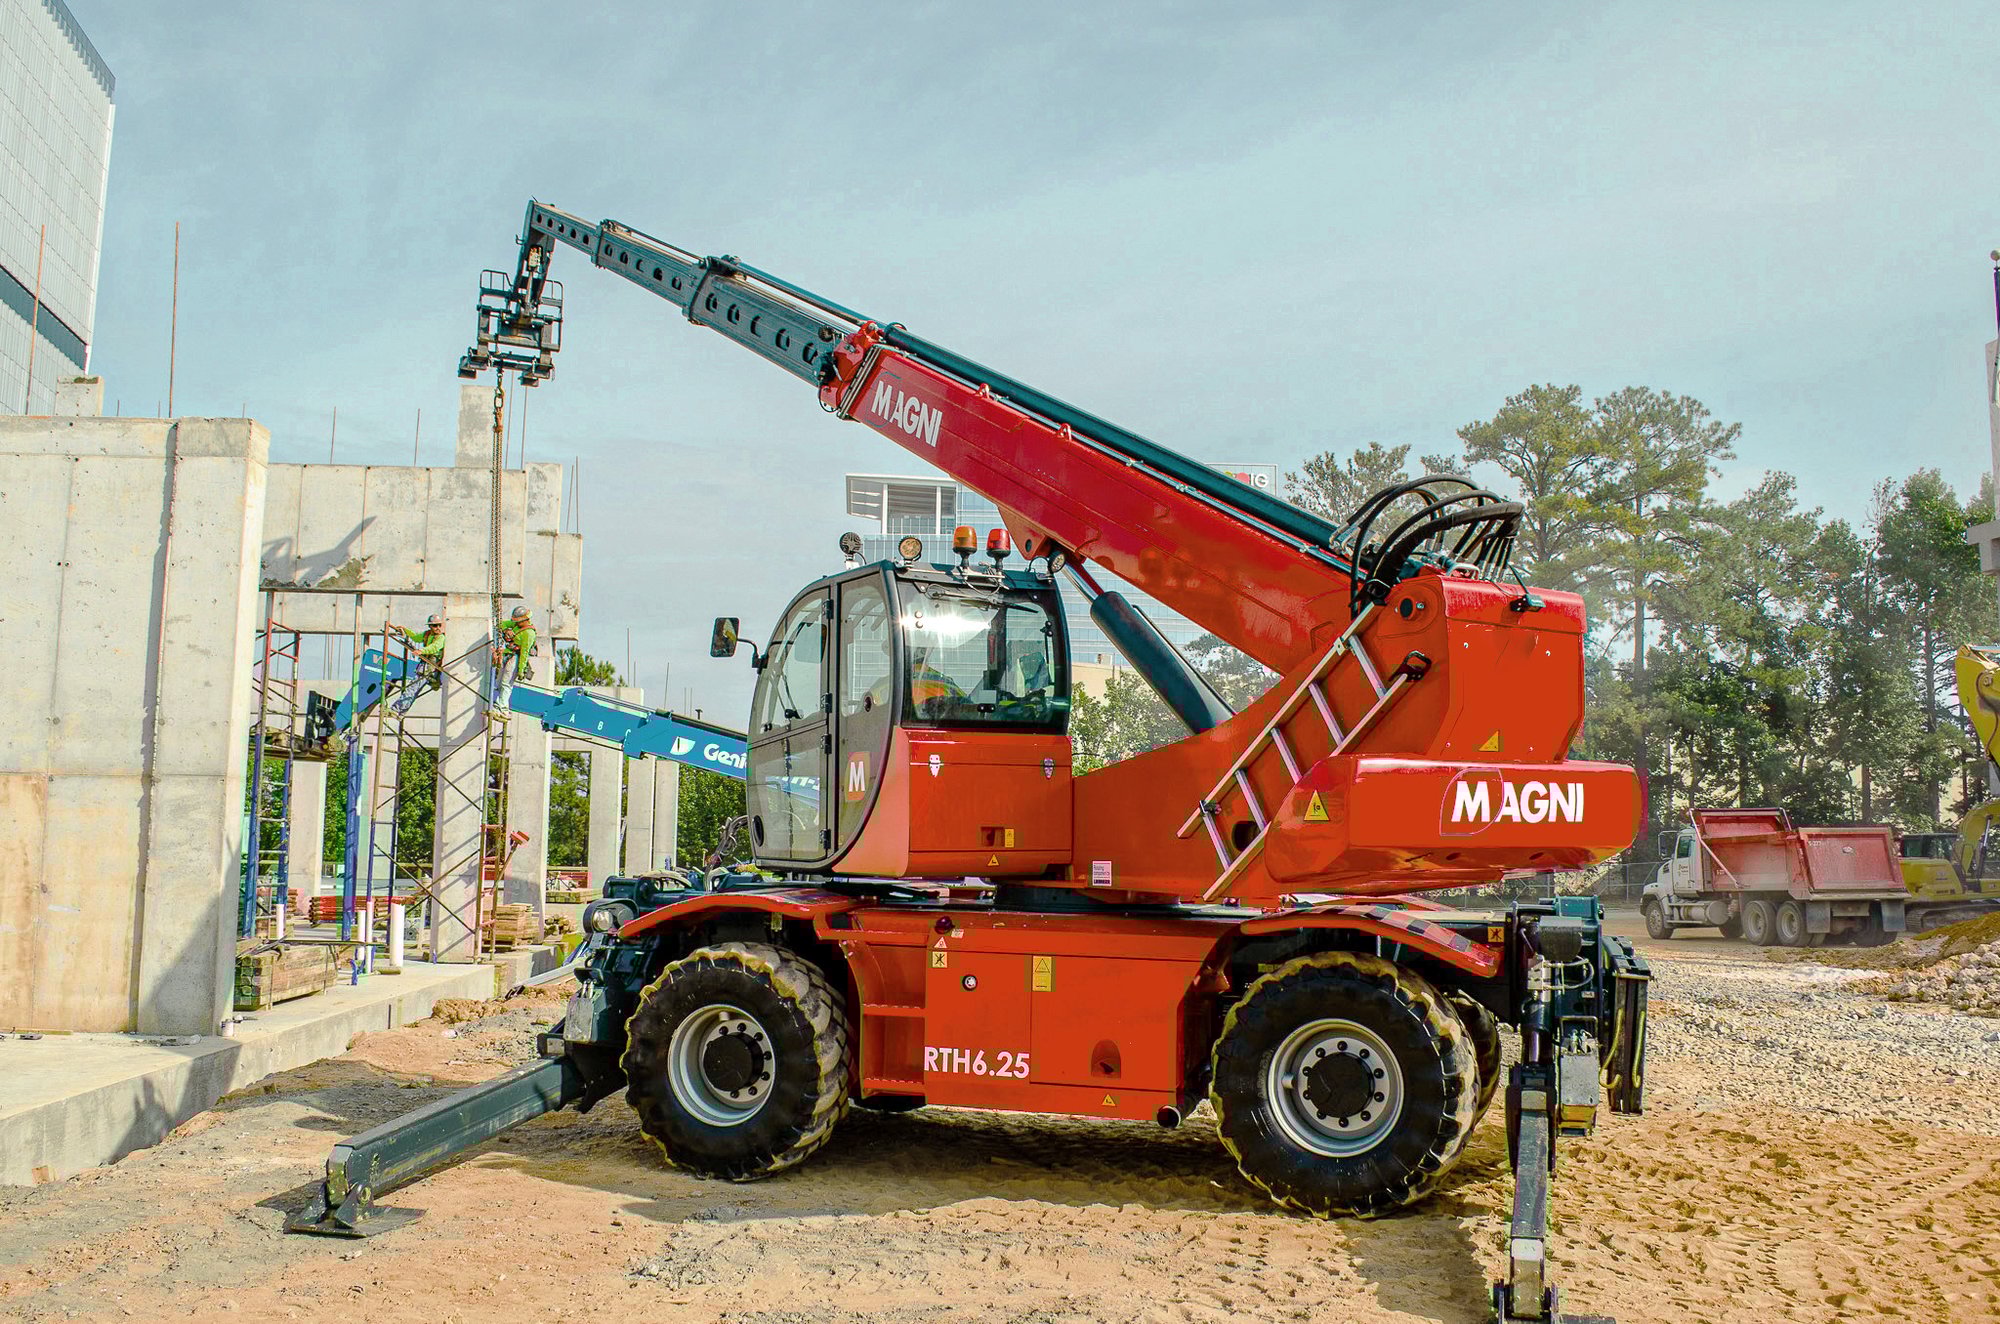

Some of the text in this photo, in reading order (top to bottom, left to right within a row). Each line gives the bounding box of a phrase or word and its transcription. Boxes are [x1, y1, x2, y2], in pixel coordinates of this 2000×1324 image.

[871, 380, 943, 448] MAGNI
[569, 713, 576, 723] A
[597, 721, 604, 731] B
[703, 743, 748, 769] Geni
[848, 761, 866, 792] M
[1451, 780, 1584, 824] MAGNI
[924, 1046, 1030, 1079] RTH6.25
